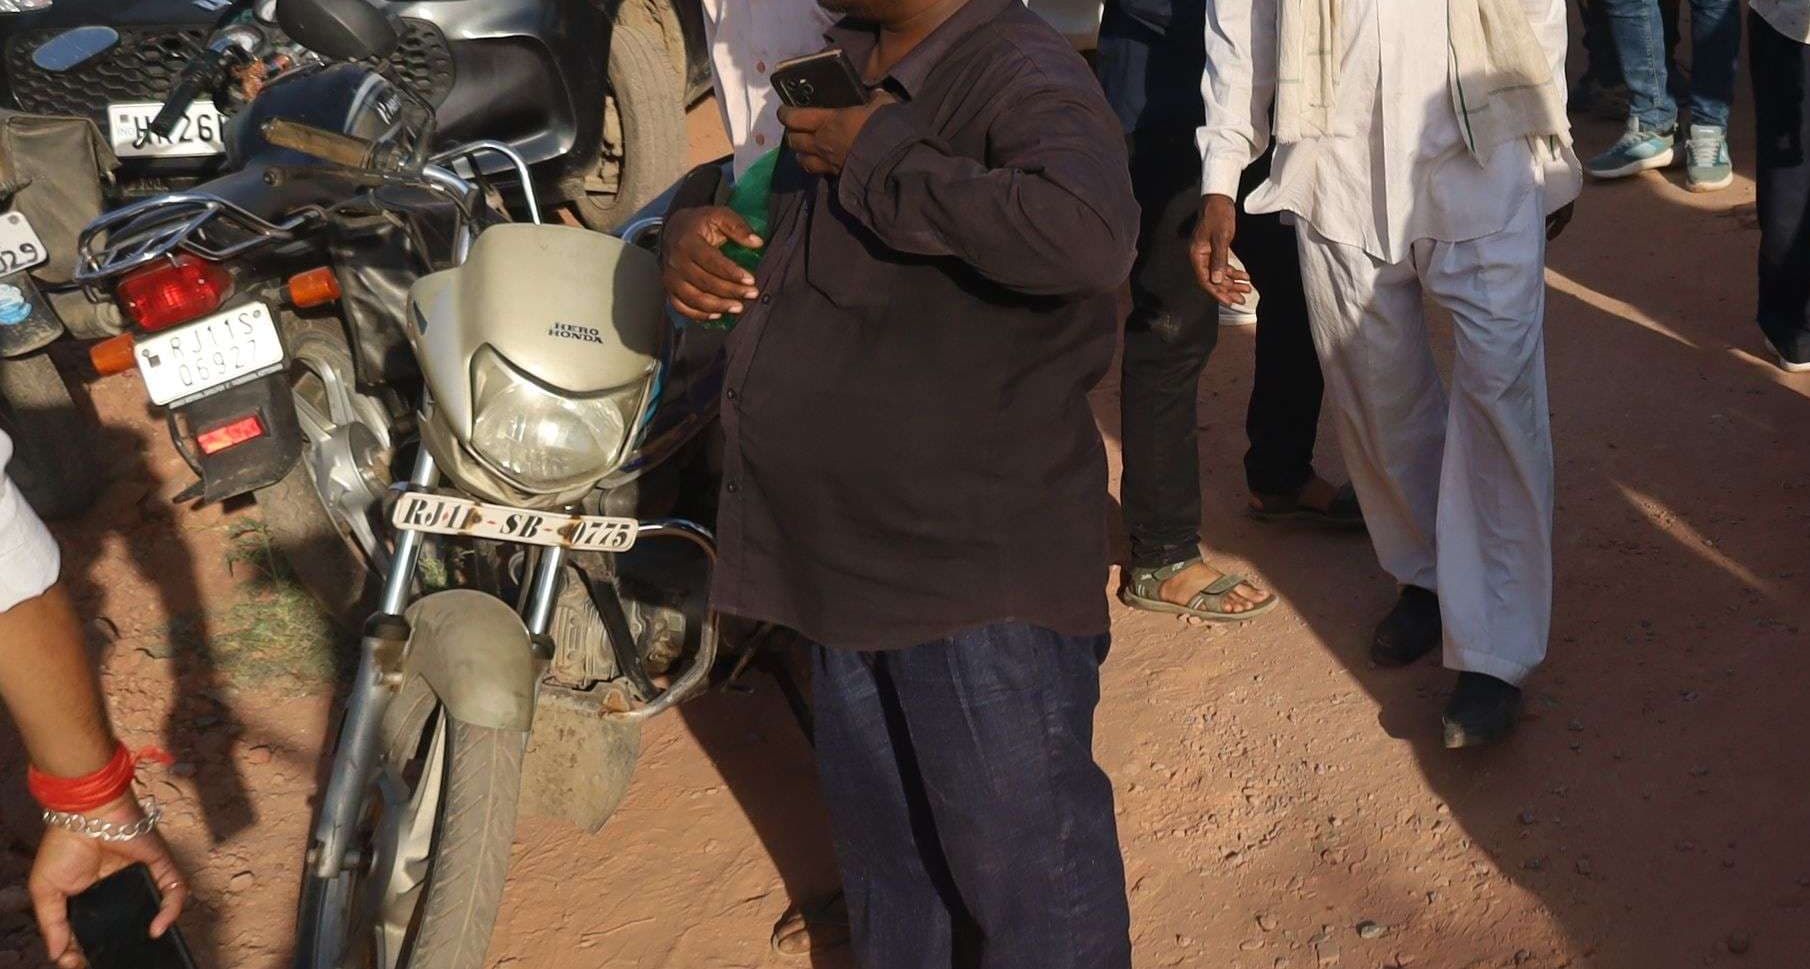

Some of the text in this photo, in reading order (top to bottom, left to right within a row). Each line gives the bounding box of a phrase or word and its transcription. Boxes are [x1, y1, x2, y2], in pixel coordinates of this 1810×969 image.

[169, 312, 254, 359] RJ11S
[548, 329, 604, 344] HONDA
[554, 322, 600, 336] HERO
[571, 521, 631, 546] 0775
